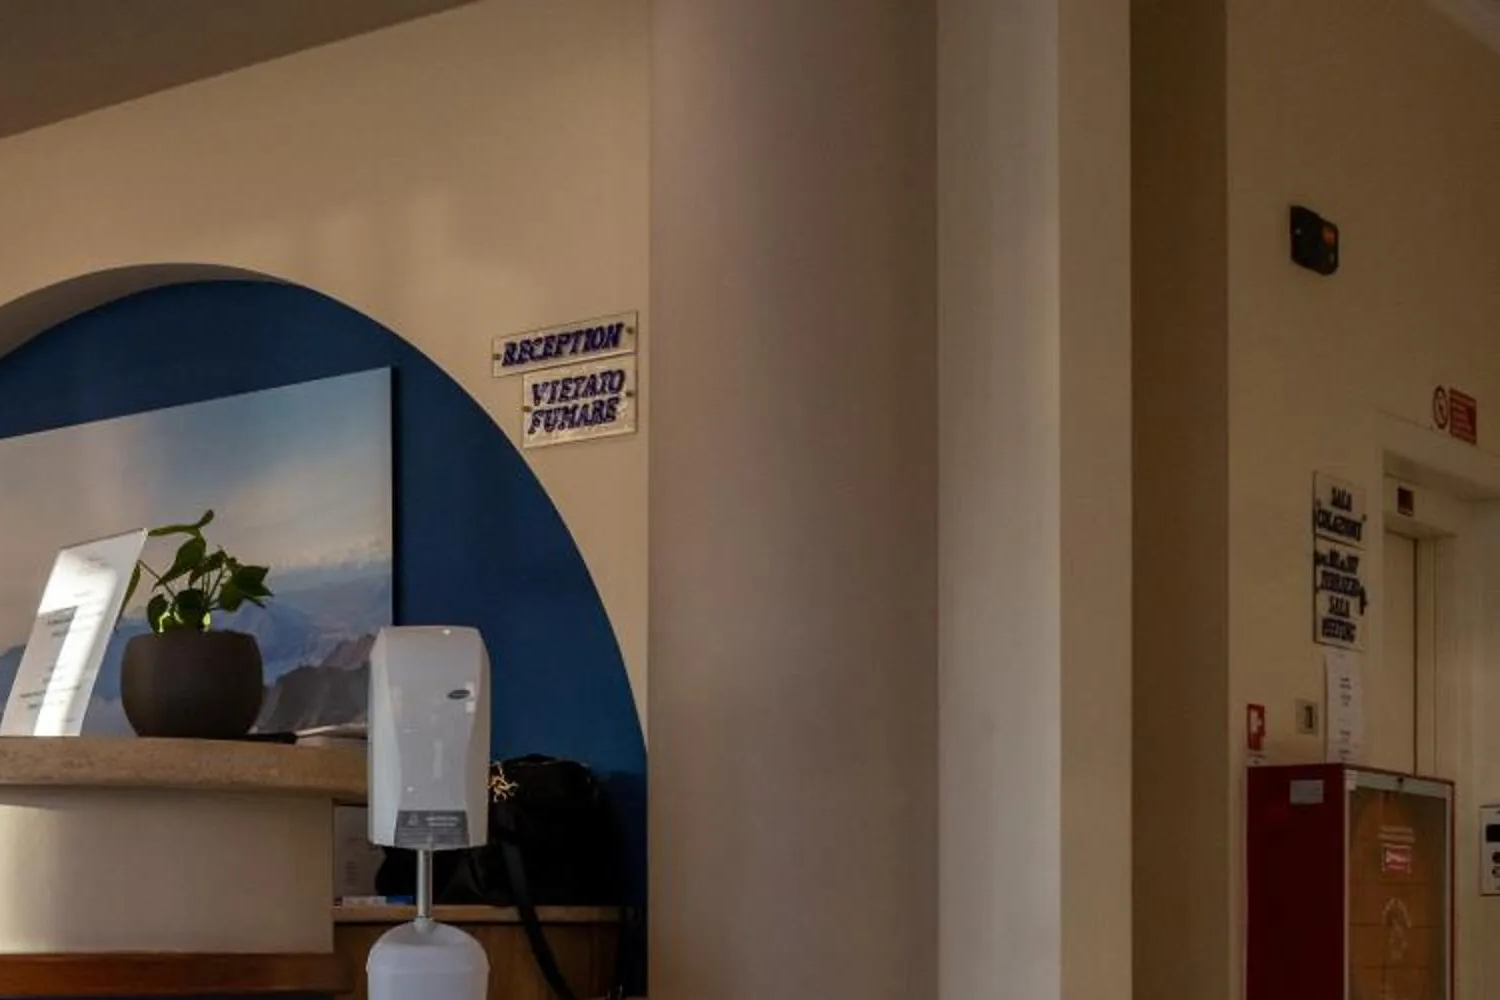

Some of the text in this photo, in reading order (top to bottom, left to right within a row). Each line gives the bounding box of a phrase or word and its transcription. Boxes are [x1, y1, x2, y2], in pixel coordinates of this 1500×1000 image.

[501, 322, 625, 367] RECEPTION
[531, 369, 626, 406] VIETATO
[527, 396, 621, 435] FUMARE
